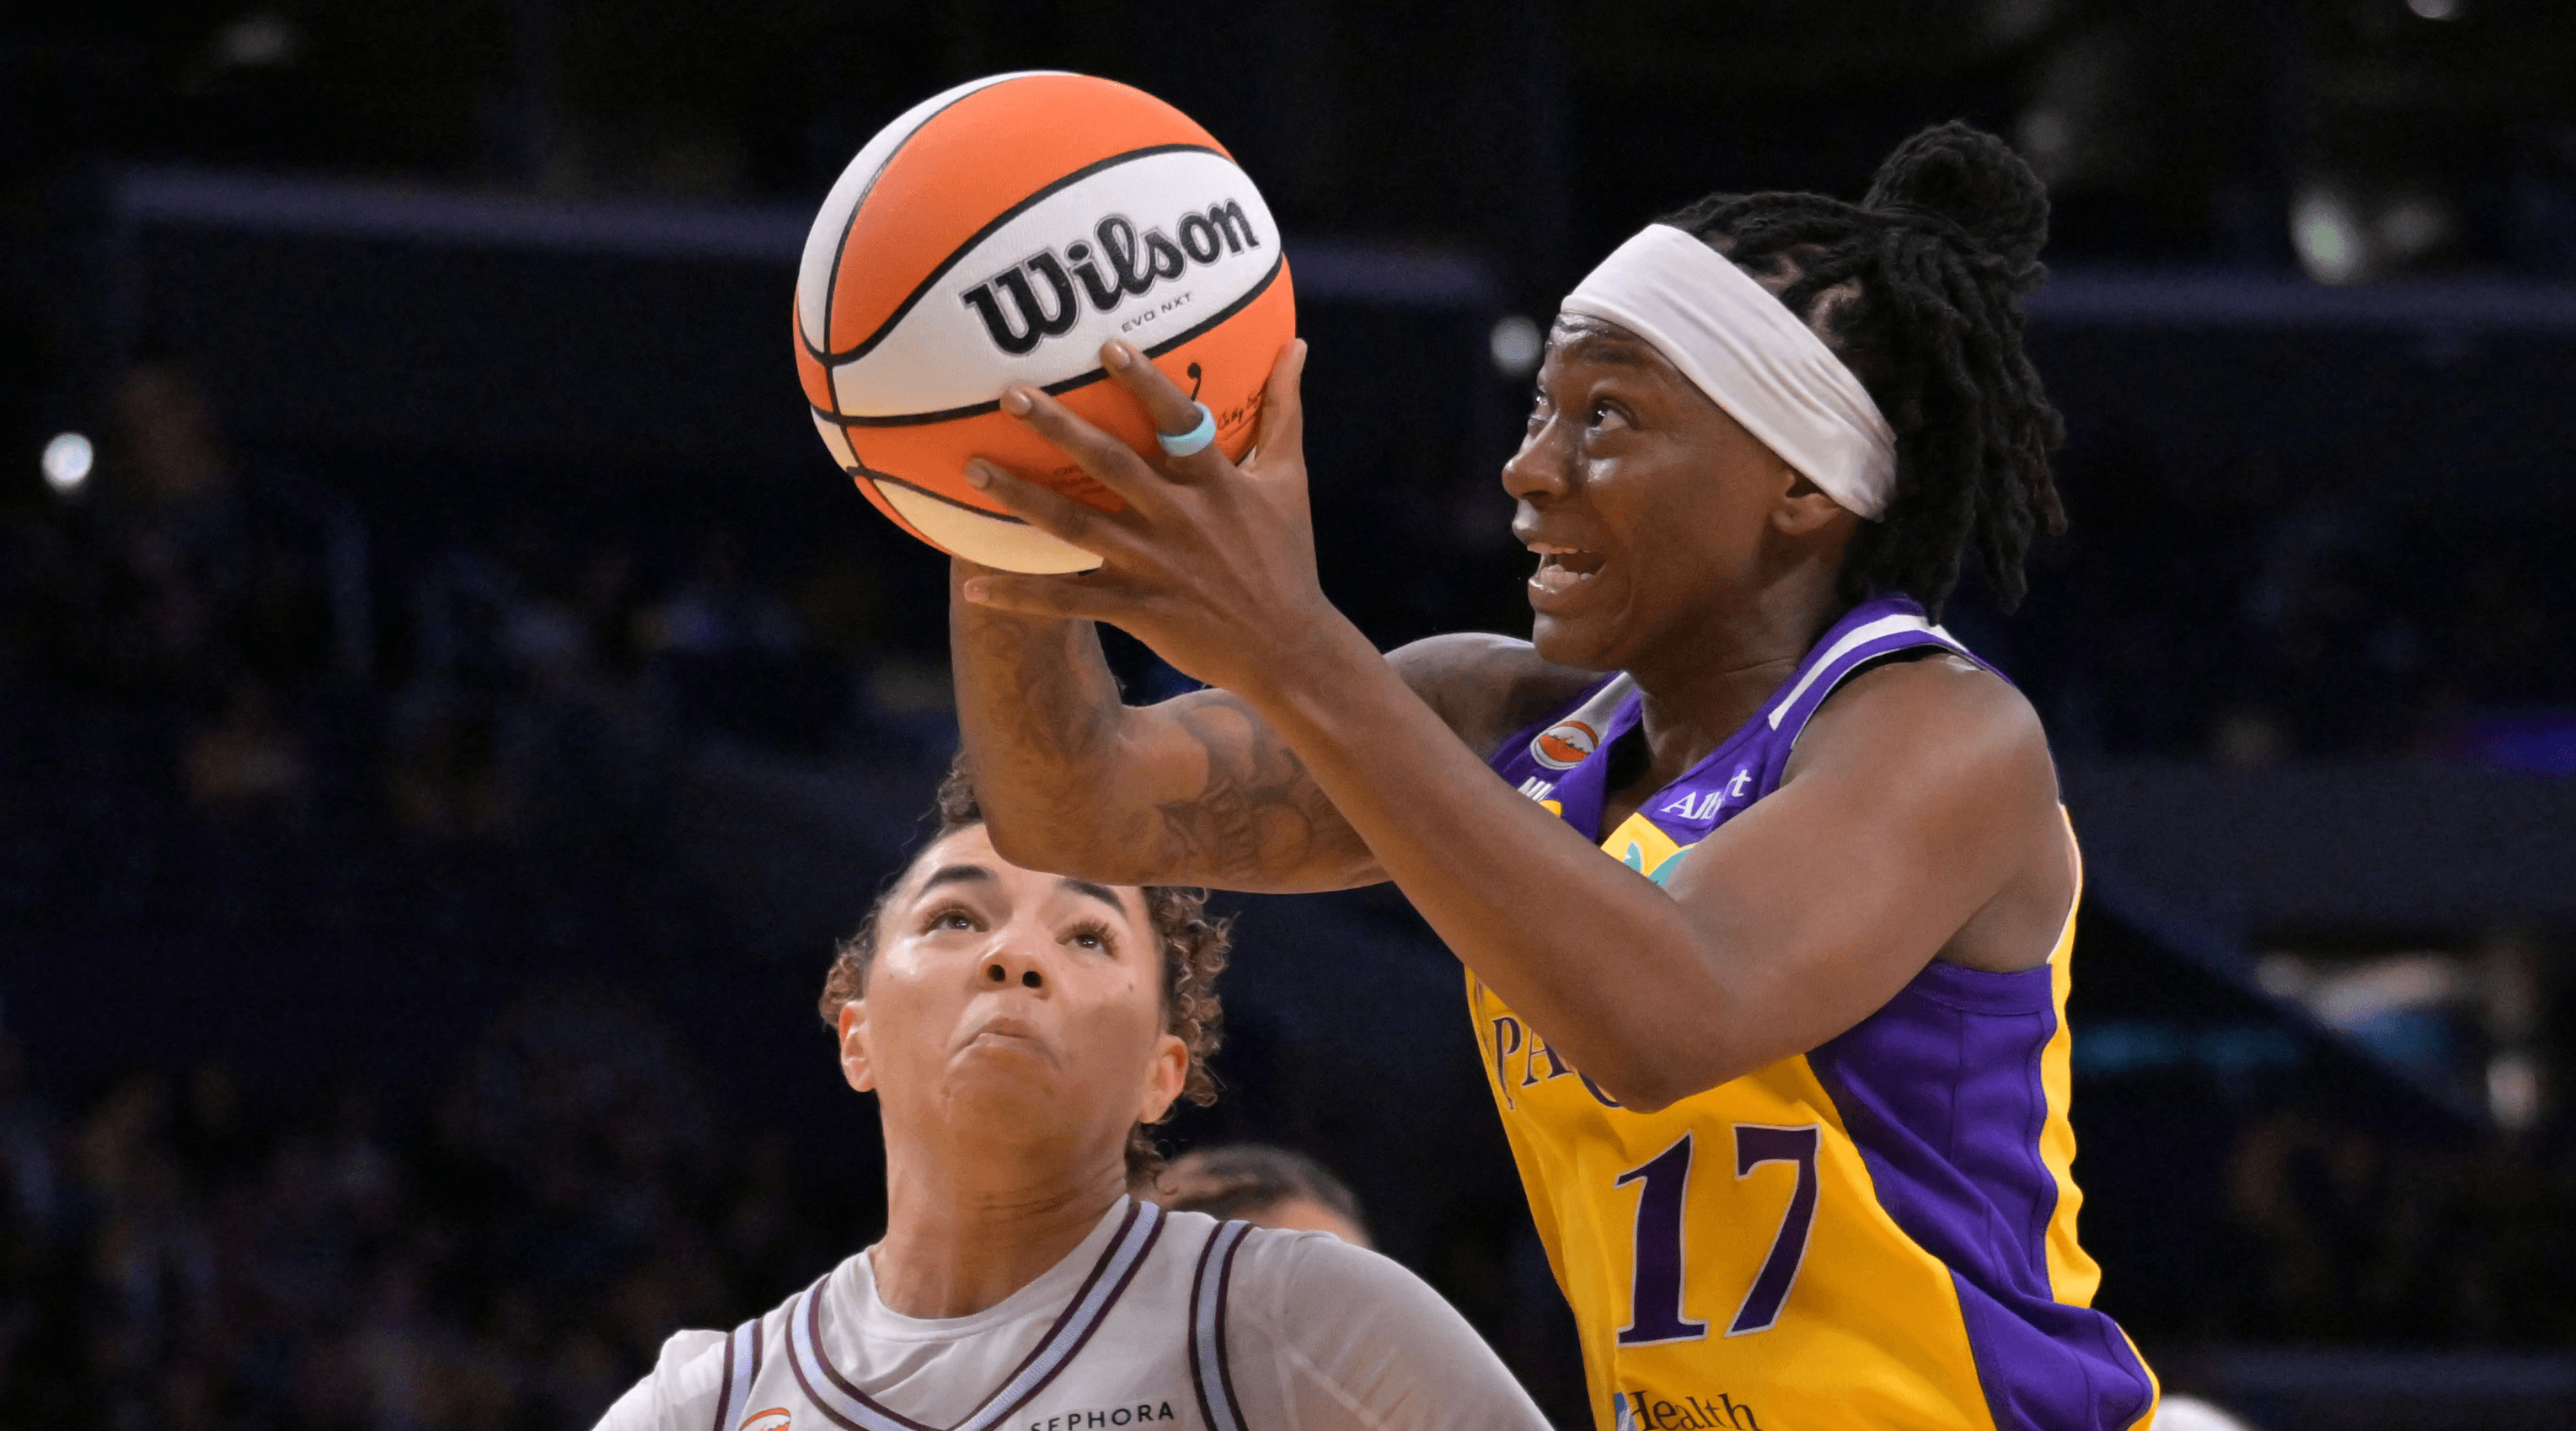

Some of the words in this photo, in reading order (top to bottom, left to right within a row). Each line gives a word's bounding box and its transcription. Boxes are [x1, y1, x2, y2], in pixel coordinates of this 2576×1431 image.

[959, 198, 1260, 357] Wilson
[1122, 310, 1155, 334] EVO
[1160, 291, 1191, 314] NXT
[1613, 1123, 1822, 1348] 17
[1629, 1390, 1763, 1431] Health
